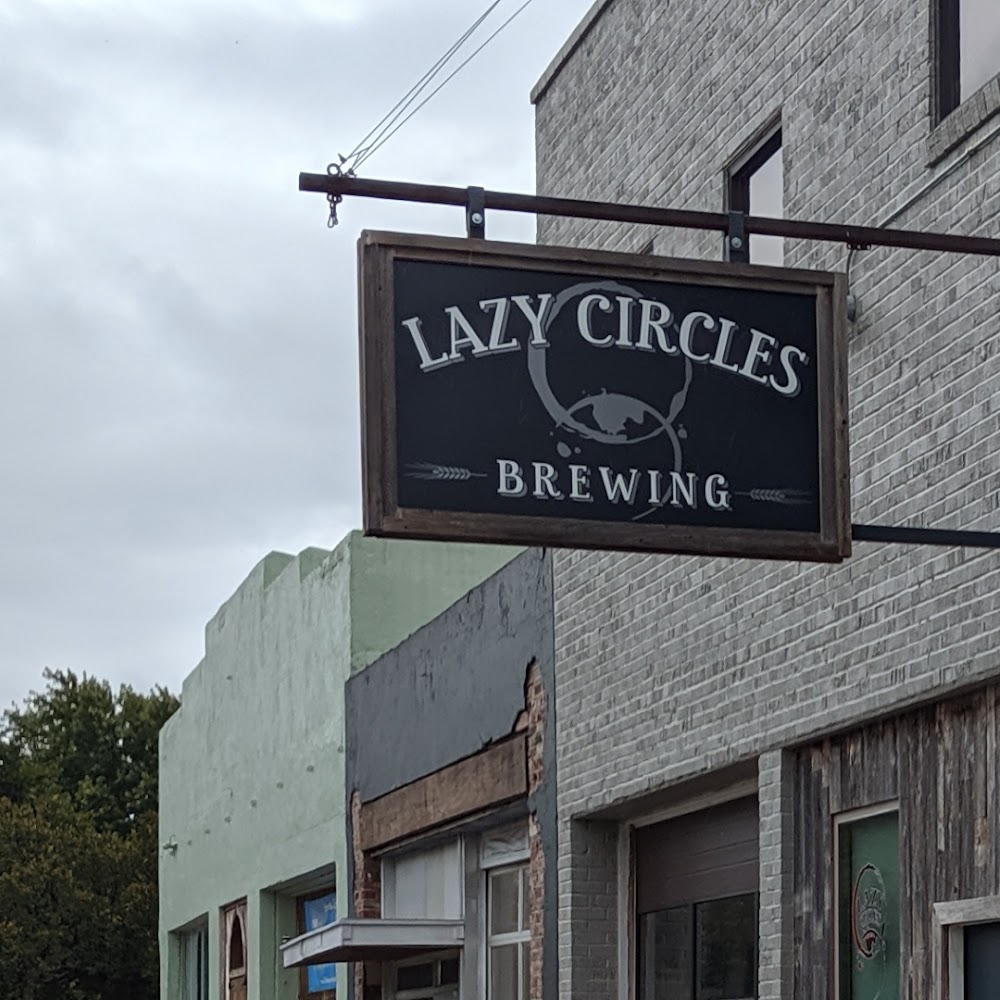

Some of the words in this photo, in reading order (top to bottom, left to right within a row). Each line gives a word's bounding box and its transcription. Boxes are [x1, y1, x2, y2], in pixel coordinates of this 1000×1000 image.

[402, 293, 556, 372] LAZY
[577, 293, 808, 398] CIRCLES
[496, 459, 732, 509] BREWING
